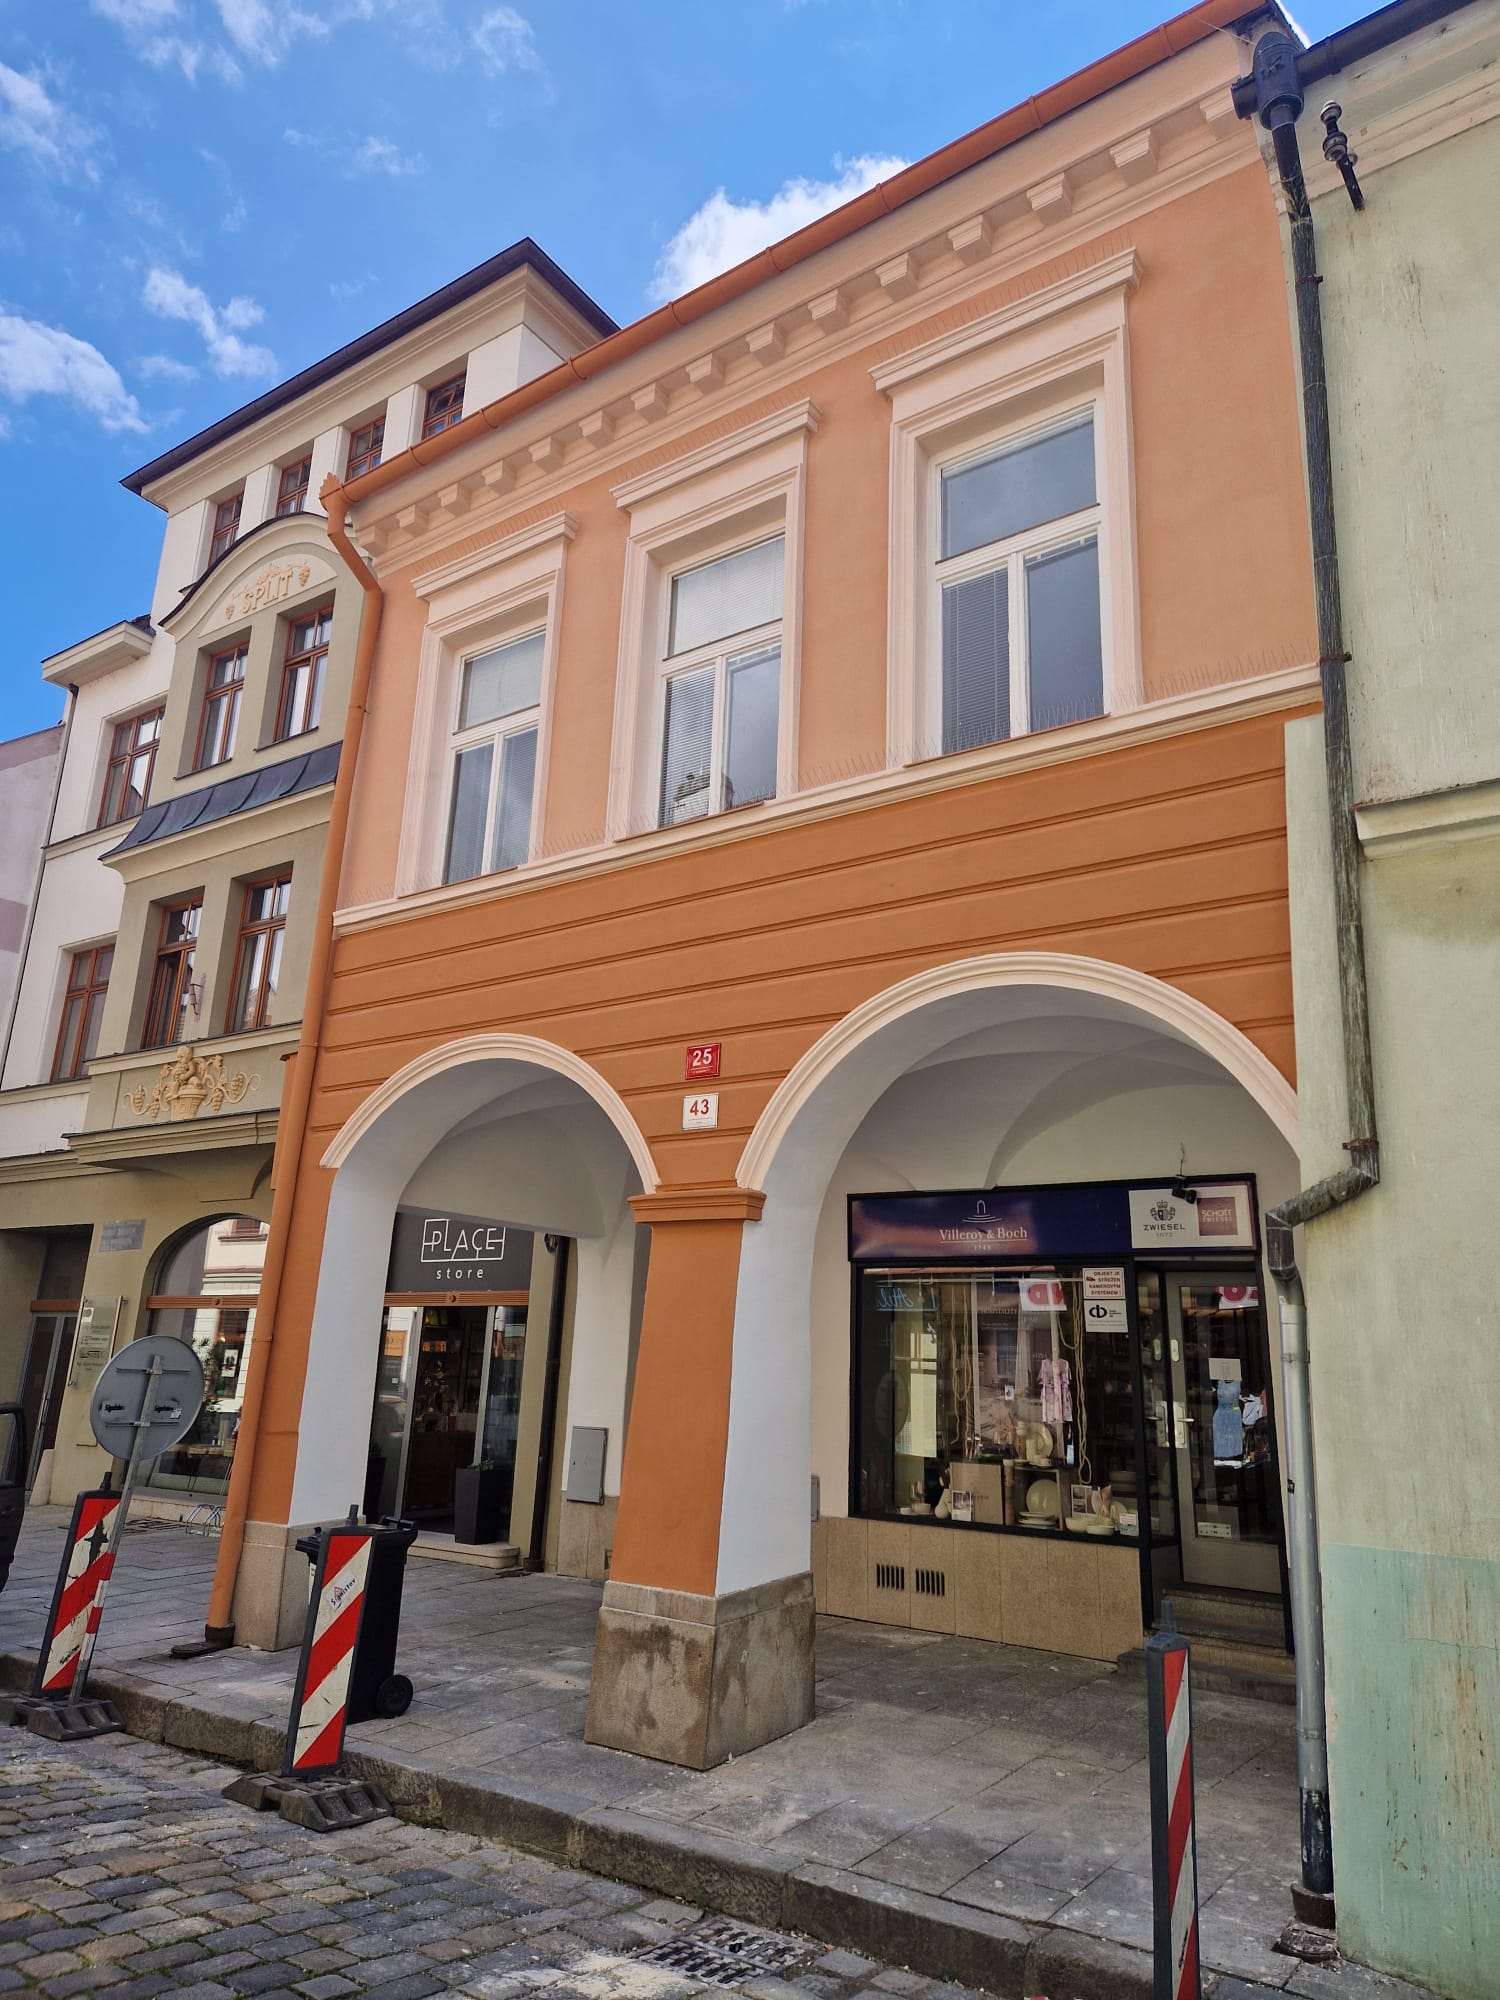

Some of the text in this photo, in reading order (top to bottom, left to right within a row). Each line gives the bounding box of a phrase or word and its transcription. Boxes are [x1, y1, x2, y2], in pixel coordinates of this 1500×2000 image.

[242, 570, 294, 614] SPLIT
[692, 1047, 712, 1067] 25
[689, 1098, 709, 1116] 43
[1201, 1209, 1232, 1217] SCHOTT
[940, 1226, 1028, 1243] Villeroy & Boch
[1143, 1223, 1185, 1231] ZWIESEL
[421, 1218, 505, 1262] PLACE
[436, 1267, 484, 1279] store
